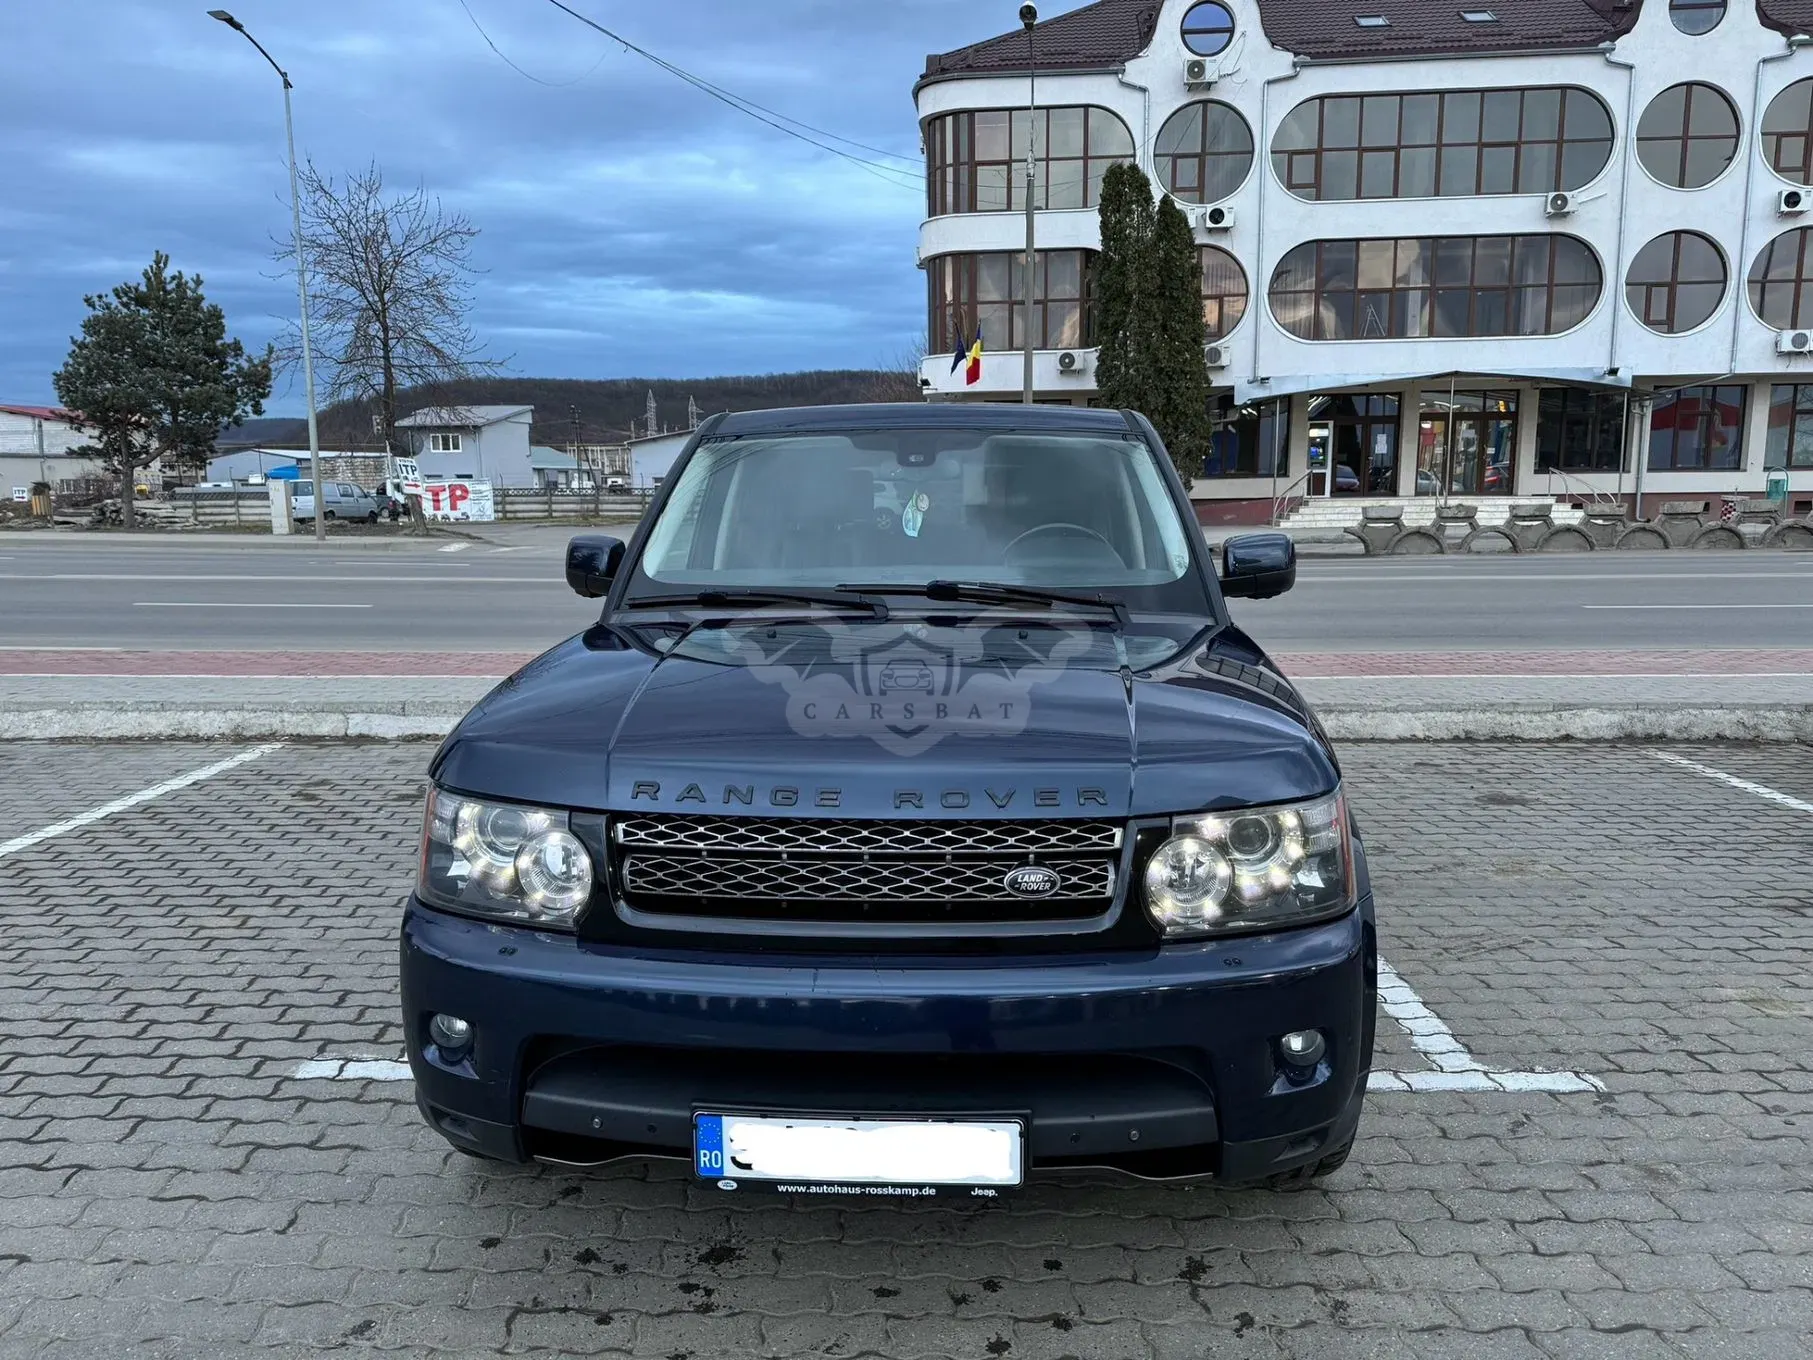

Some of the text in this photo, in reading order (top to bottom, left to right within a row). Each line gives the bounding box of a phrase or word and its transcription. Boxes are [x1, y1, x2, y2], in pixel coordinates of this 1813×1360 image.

[399, 464, 418, 476] ITP
[417, 483, 469, 511] TP
[631, 780, 1108, 809] RANGE ROVER
[1017, 874, 1043, 882] LAND
[1020, 882, 1051, 891] ROVER
[700, 1149, 721, 1168] RO
[777, 1184, 936, 1197] www.autohaus-rosskamp.de
